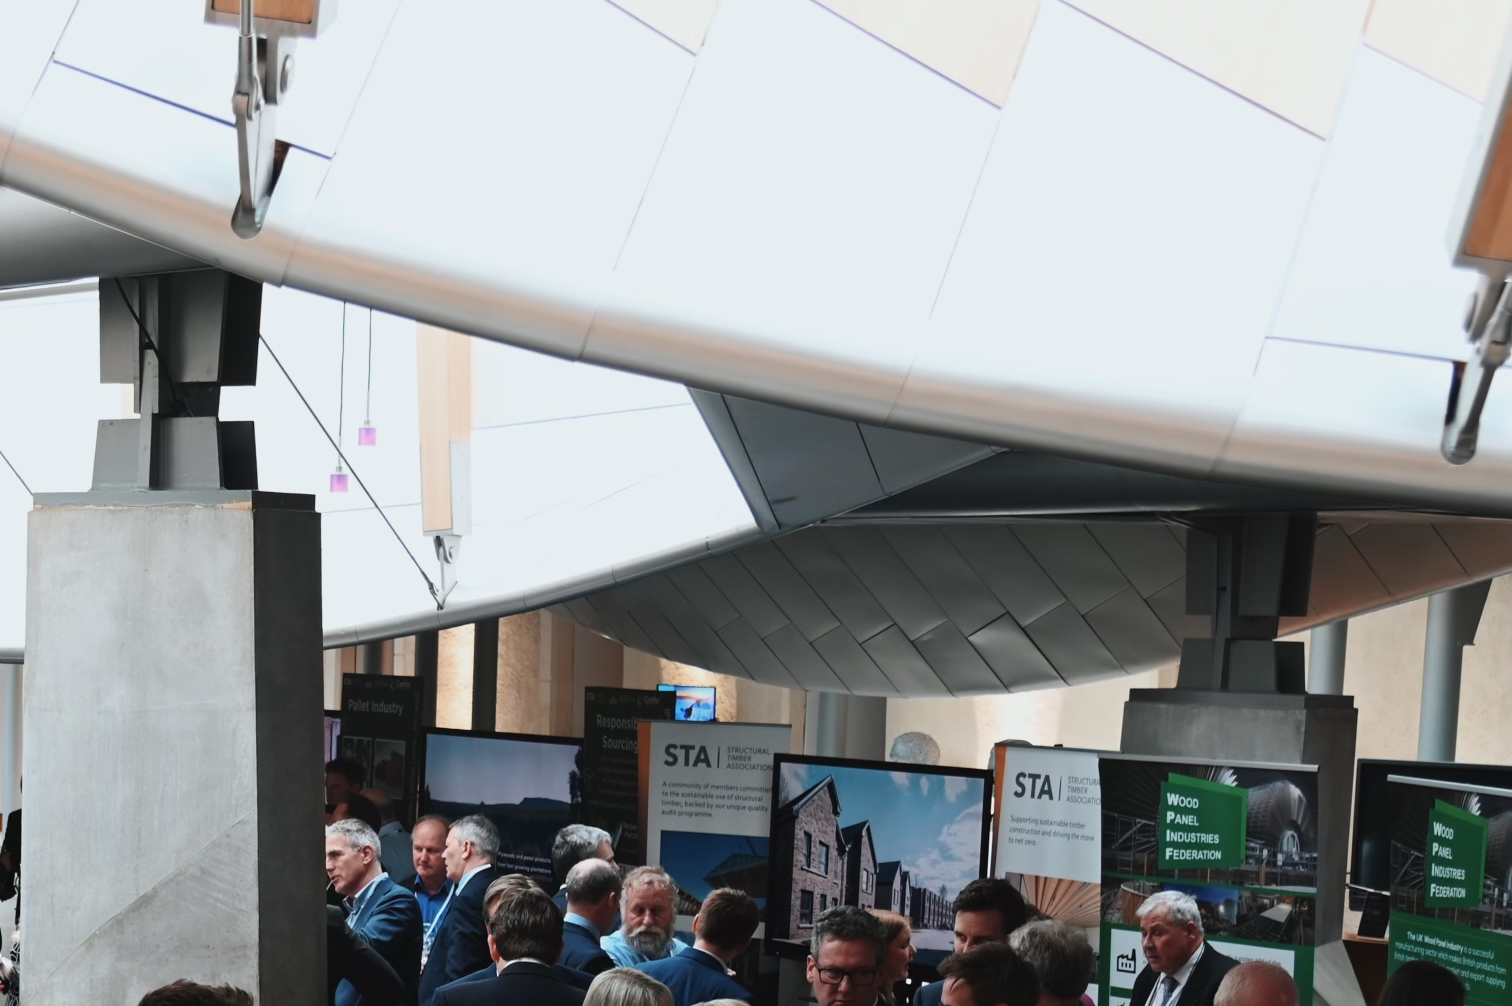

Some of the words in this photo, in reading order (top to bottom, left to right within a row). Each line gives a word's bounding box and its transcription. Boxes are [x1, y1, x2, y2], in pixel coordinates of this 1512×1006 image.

[348, 698, 370, 712] Pallet
[371, 700, 404, 717] Industry
[596, 714, 640, 731] Responsib
[664, 744, 712, 768] STA
[727, 747, 770, 756] STRUCTURAL
[727, 754, 752, 762] TIMBER
[668, 782, 702, 790] community
[1014, 772, 1054, 800] STA
[1068, 776, 1100, 786] STRUCTURA
[1068, 786, 1088, 794] TIMBER
[1066, 796, 1101, 806] ASSOCIATIO
[706, 802, 714, 810] by
[726, 804, 746, 812] unique
[748, 804, 768, 813] quality
[1010, 814, 1038, 827] Supporting
[1039, 819, 1068, 828] sustainable
[1069, 822, 1086, 830] timber
[1009, 826, 1040, 836] construction
[1052, 830, 1070, 842] driving
[1080, 834, 1094, 842] move
[1407, 931, 1416, 941] The
[1424, 935, 1436, 945] Wood
